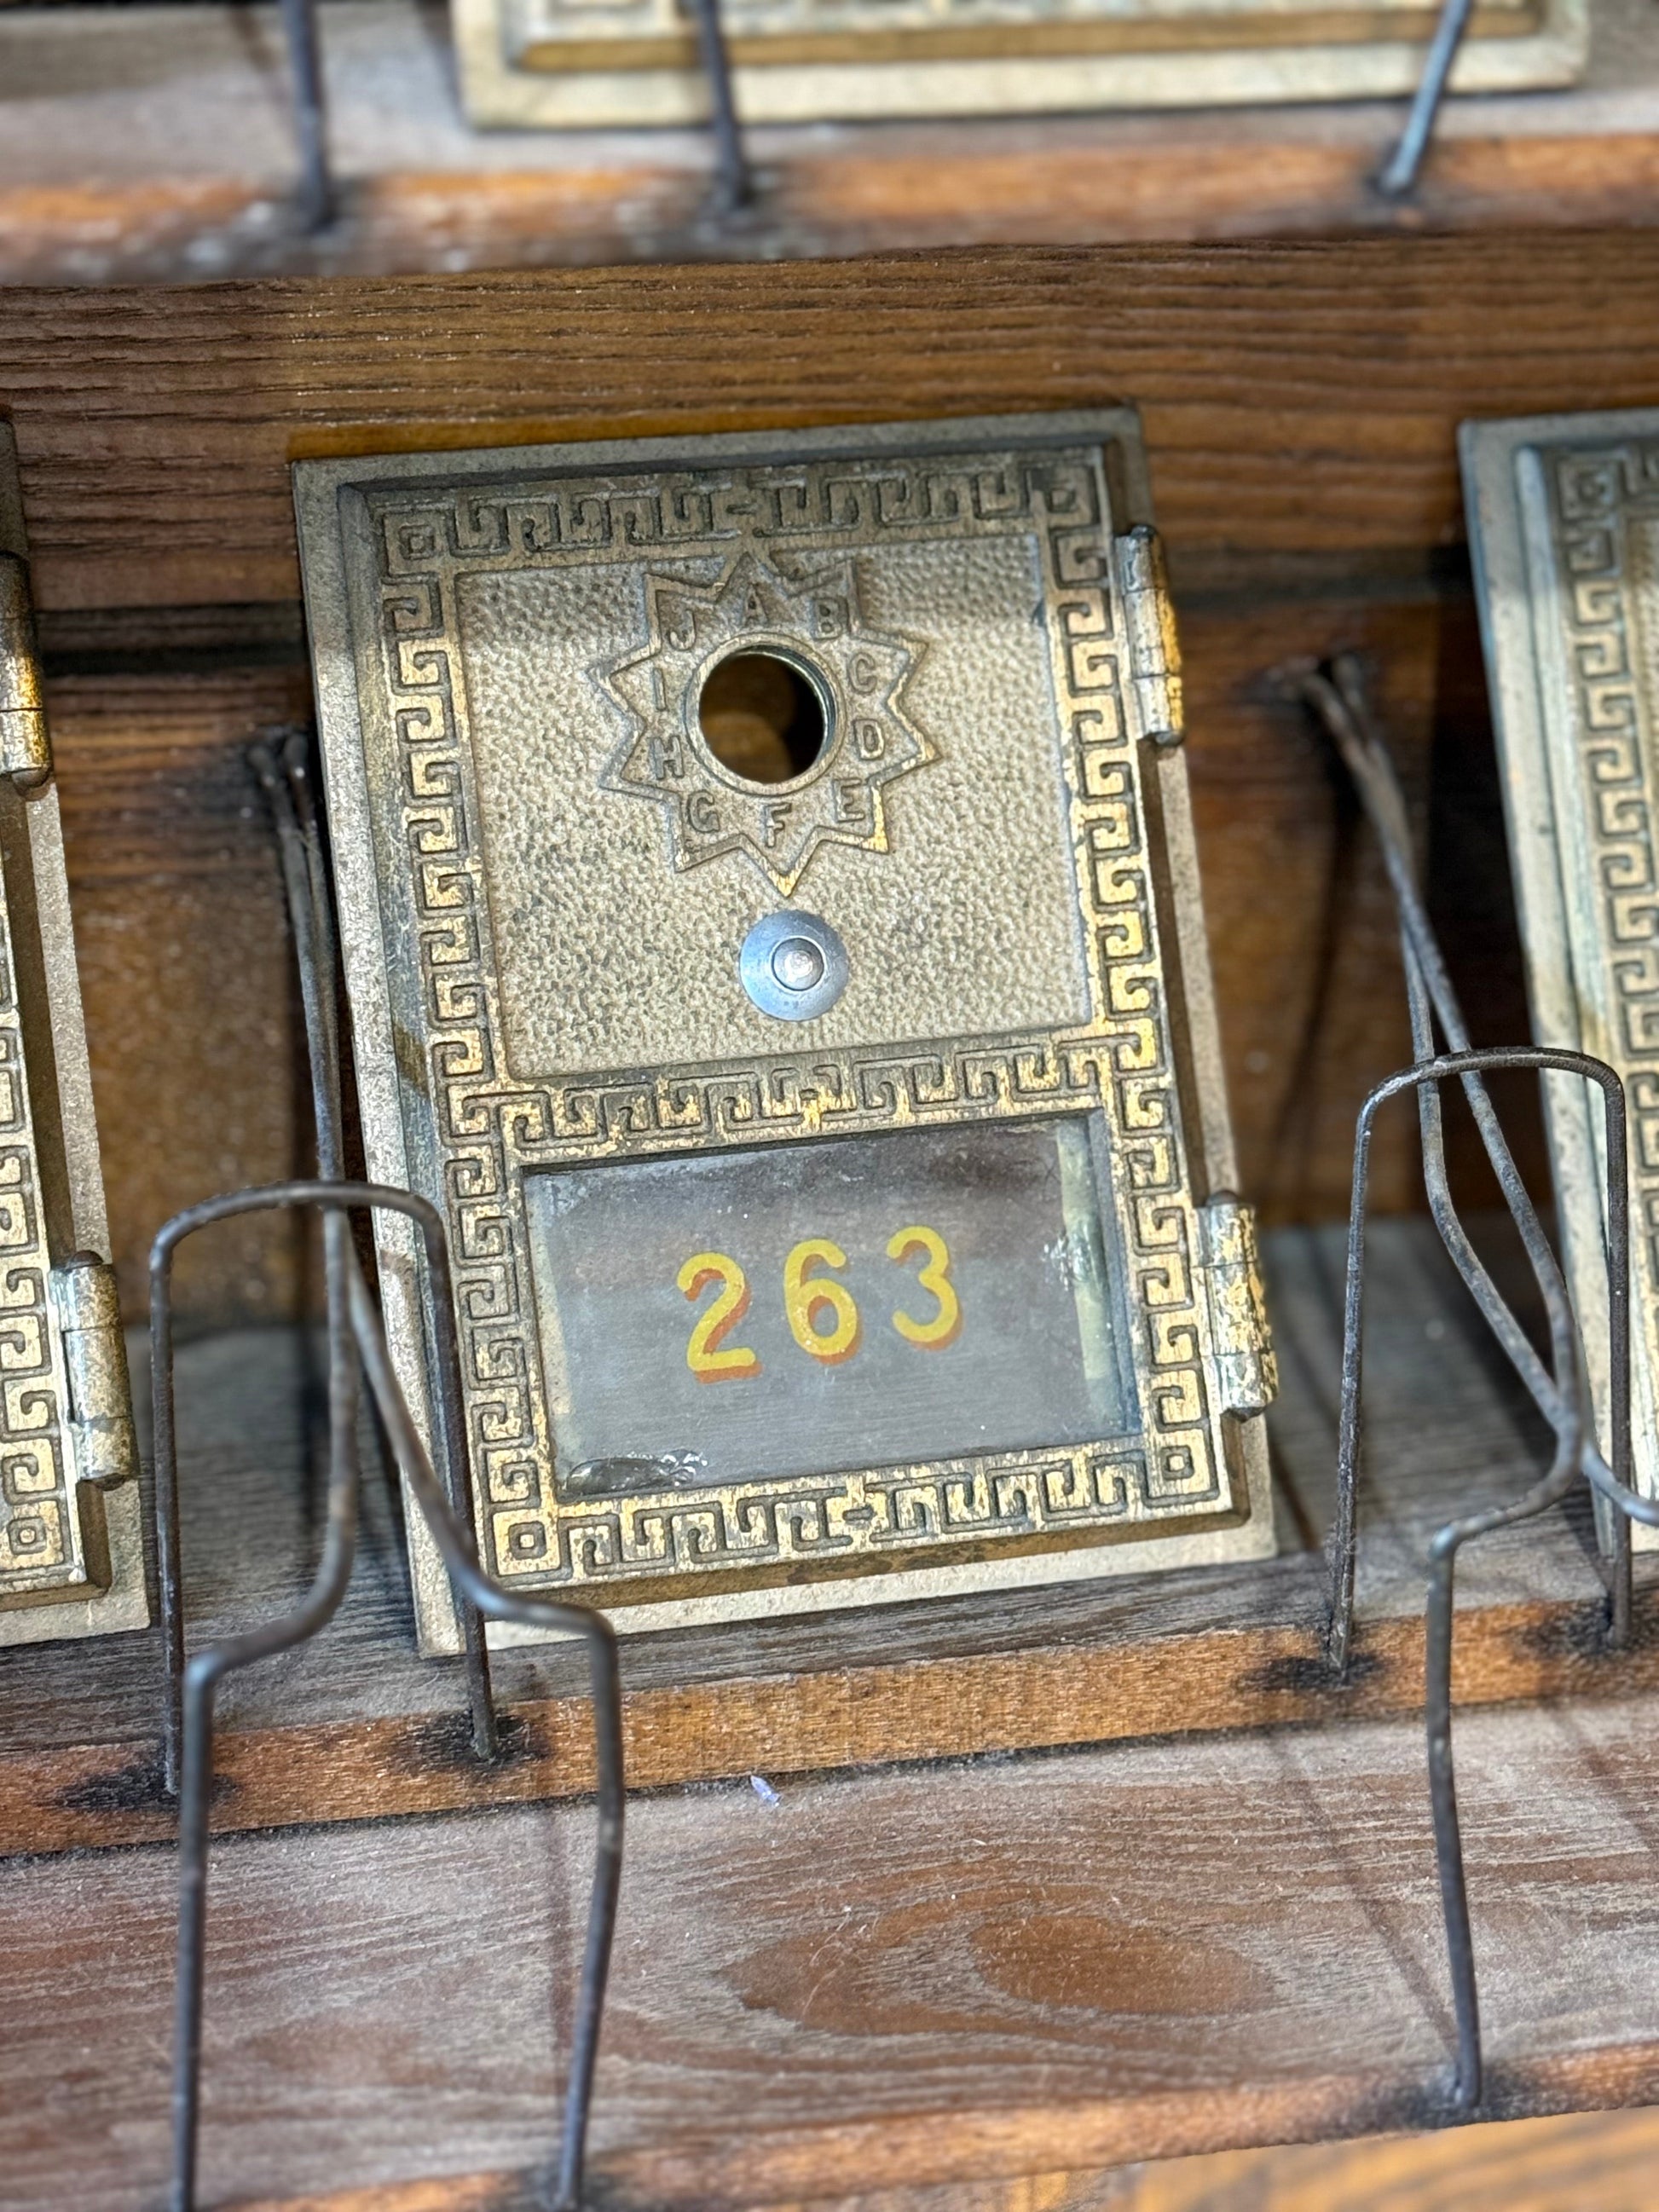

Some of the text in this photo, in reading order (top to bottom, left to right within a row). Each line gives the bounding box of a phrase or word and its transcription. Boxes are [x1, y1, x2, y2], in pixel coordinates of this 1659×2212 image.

[650, 582, 885, 847] A B C D E F G H I J
[677, 1226, 963, 1385] 263
